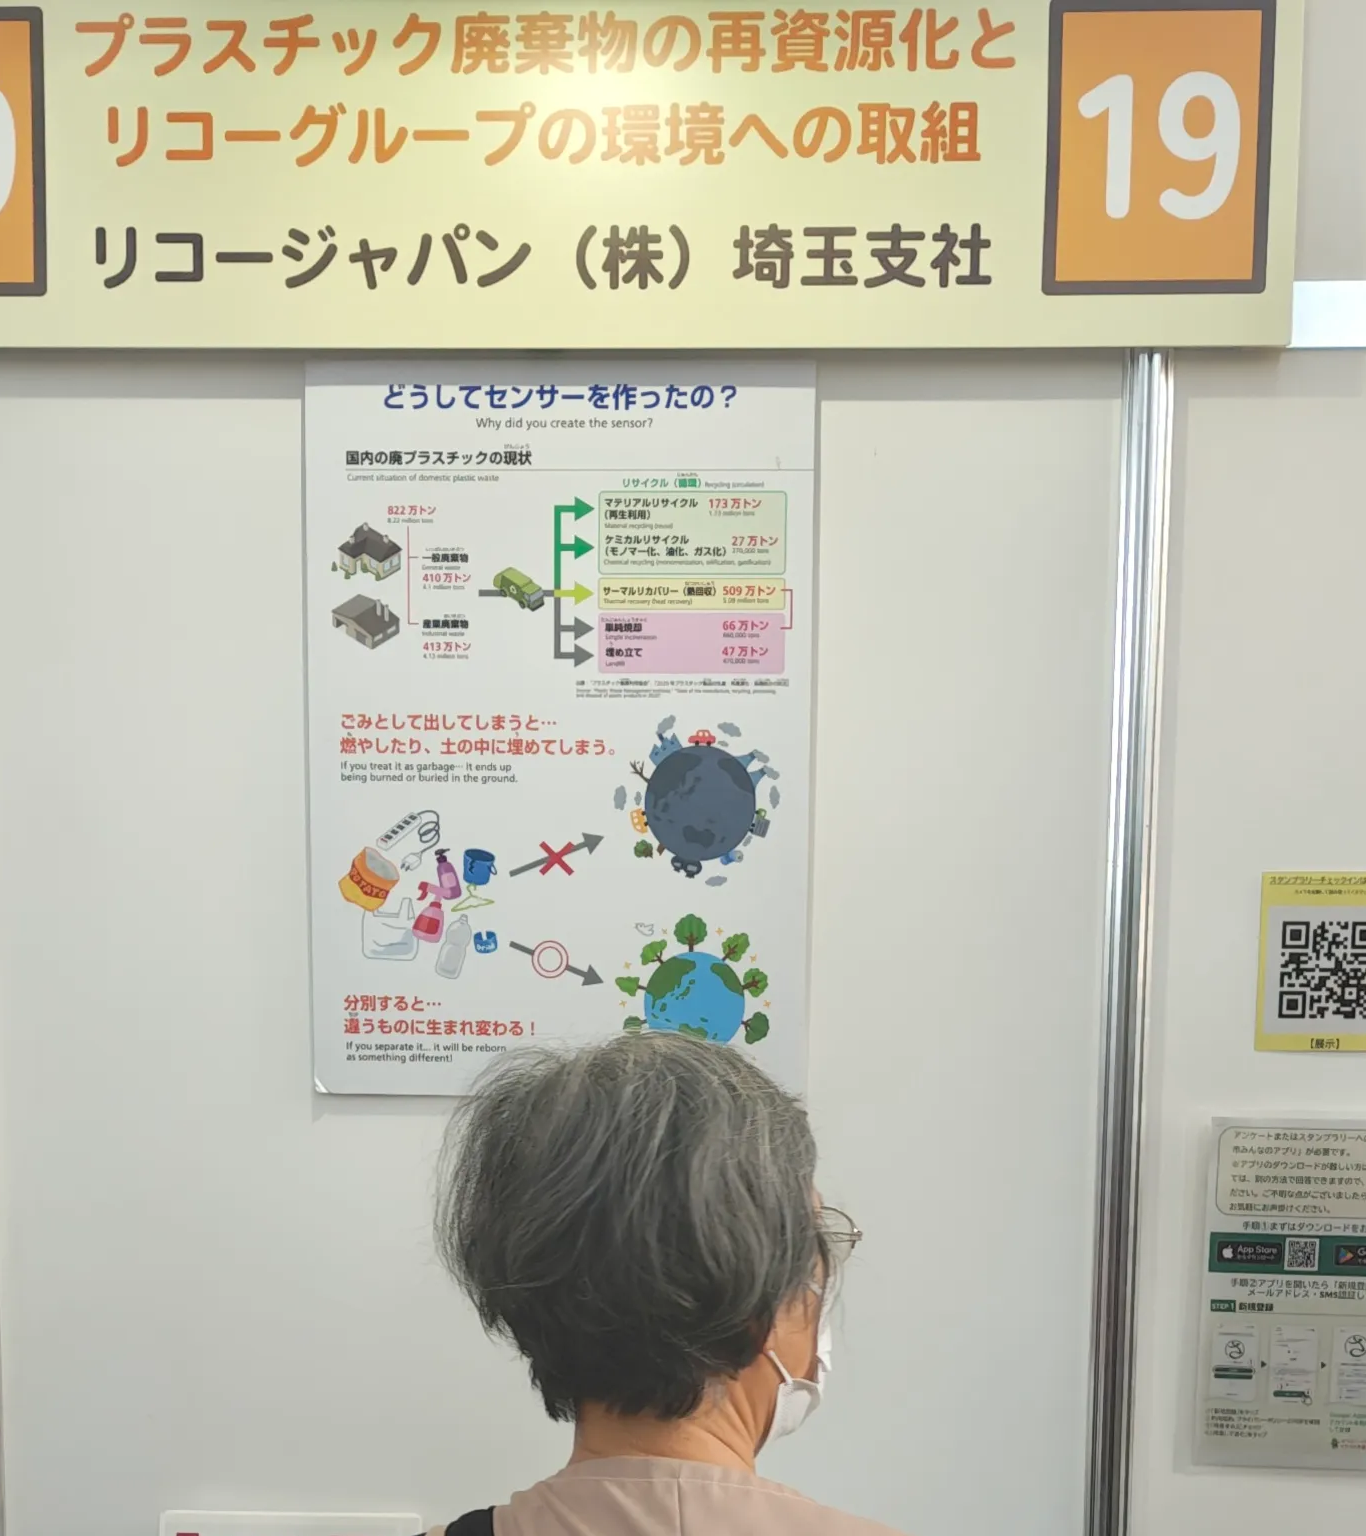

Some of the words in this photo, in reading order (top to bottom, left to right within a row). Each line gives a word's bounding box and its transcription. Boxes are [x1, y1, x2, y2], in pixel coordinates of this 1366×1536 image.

[77, 8, 1021, 76] プラスチック廃棄物の再資源化と
[105, 102, 983, 170] リコーグループの環境への取組
[1076, 70, 1241, 222] 19
[92, 224, 993, 292] リコージャパン（株）埼玉支社
[383, 384, 738, 411] どうしてセンサーを作ったの？
[475, 416, 501, 431] Why
[505, 416, 523, 431] did
[526, 416, 547, 431] you
[550, 416, 585, 431] create
[589, 416, 607, 431] the
[611, 416, 653, 431] sensor?
[345, 450, 532, 466] 国内の廃プラスチックの現状
[604, 498, 698, 508] マテリアルリサイクル
[709, 499, 728, 509] 173
[731, 498, 762, 509] 万トン
[387, 506, 405, 515] 822
[408, 505, 437, 516] 万トン
[605, 535, 689, 545] ケミカルリサイクル
[731, 536, 745, 546] 27
[748, 536, 779, 546] 万トン
[422, 573, 442, 583] 410
[444, 572, 471, 583] 万トン
[723, 586, 742, 596] 509
[745, 586, 776, 597] 万トン
[723, 621, 736, 631] 66
[739, 620, 769, 631] 万トン
[422, 642, 441, 652] 413
[444, 642, 471, 652] 万トン
[605, 647, 643, 657] 埋め立て
[722, 647, 736, 657] 47
[738, 646, 768, 657] 万トン
[340, 714, 558, 732] ごみとして出してしまうと…
[340, 737, 616, 756] 燃やしたり、土の中に埋めてしまう。
[340, 761, 347, 774] If
[350, 761, 367, 774] you
[370, 761, 392, 774] treat
[395, 761, 402, 774] it
[404, 761, 414, 774] as
[416, 761, 464, 774] garbage…
[466, 761, 472, 774] it
[475, 761, 497, 774] ends
[500, 761, 512, 774] up
[340, 772, 367, 784] being
[370, 772, 403, 784] burned
[406, 772, 416, 784] or
[418, 772, 449, 784] buried
[452, 772, 460, 784] in
[463, 772, 478, 784] the
[481, 772, 518, 784] ground.
[343, 995, 442, 1012] 分別すると…
[343, 1018, 536, 1036] 違うものに生まれ変わる！
[1310, 1039, 1340, 1050] 【展示】
[346, 1052, 356, 1064] as
[358, 1052, 406, 1064] something
[409, 1052, 453, 1064] different!
[1237, 1245, 1255, 1256] App
[1256, 1246, 1278, 1254] Store
